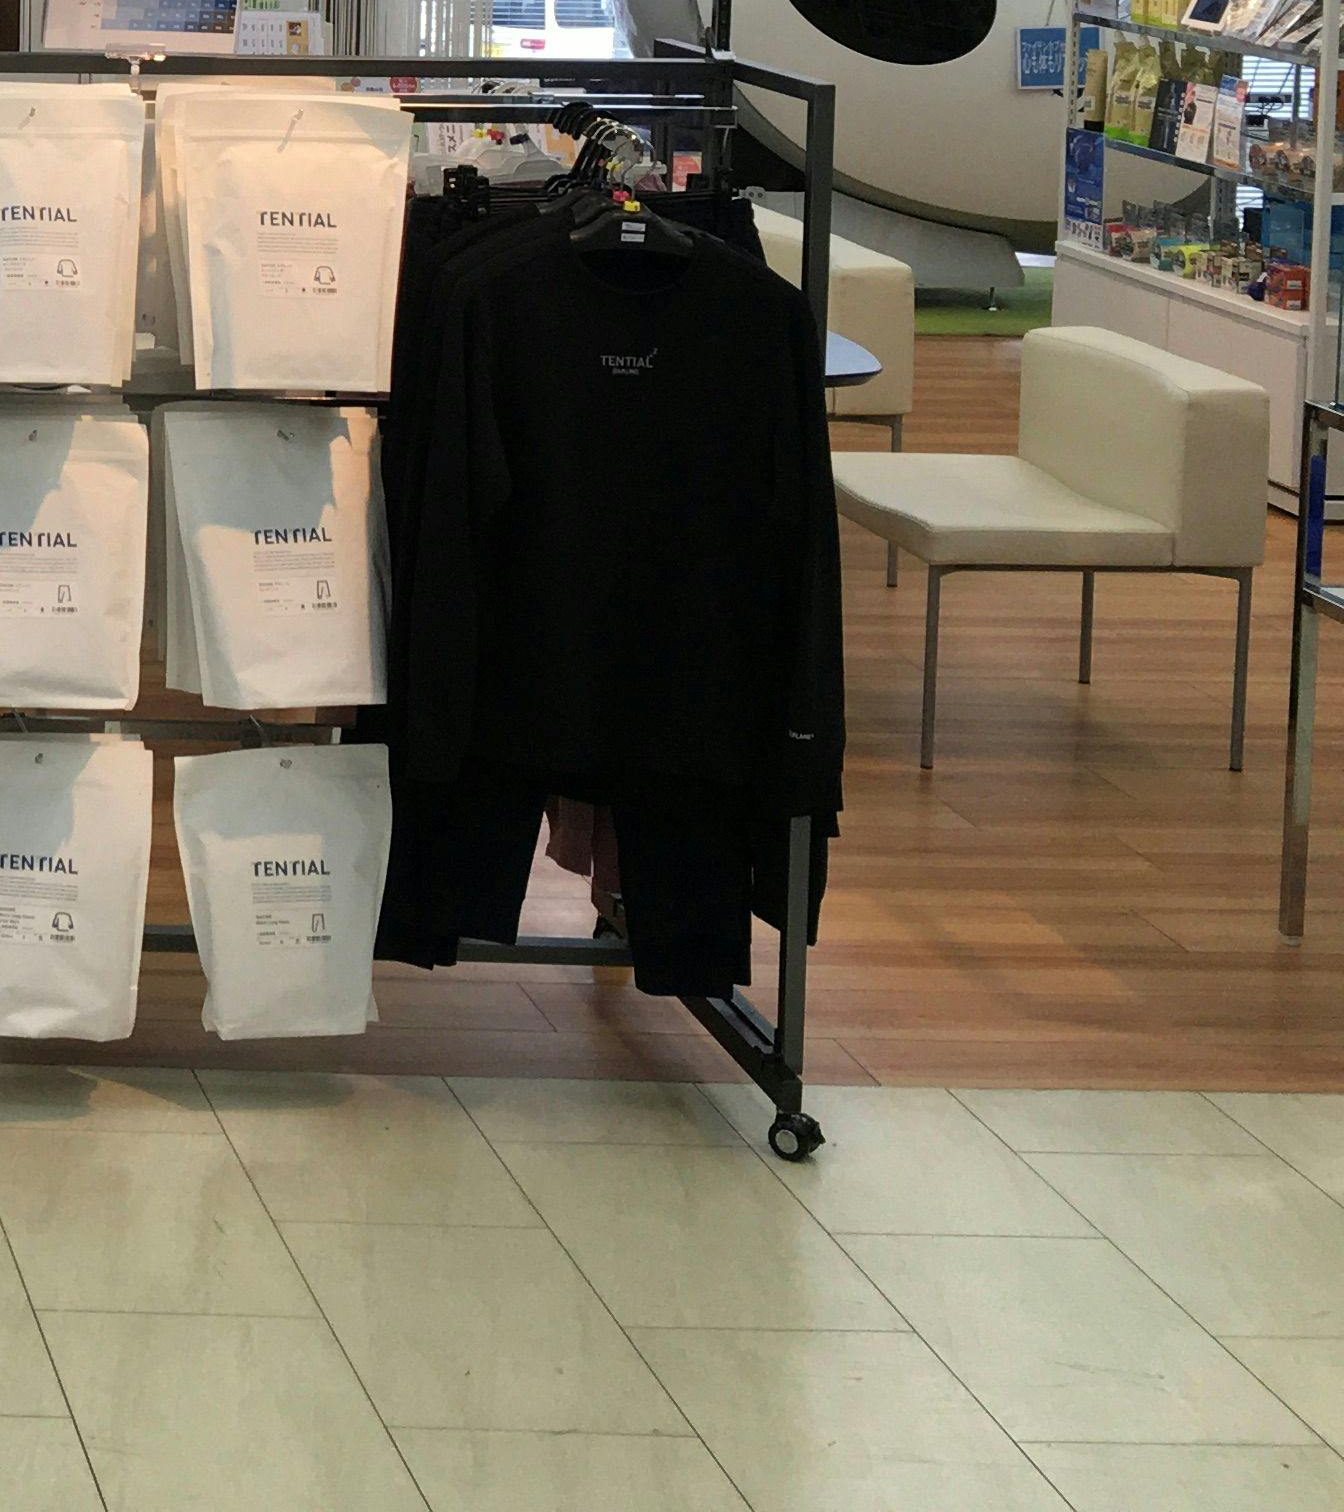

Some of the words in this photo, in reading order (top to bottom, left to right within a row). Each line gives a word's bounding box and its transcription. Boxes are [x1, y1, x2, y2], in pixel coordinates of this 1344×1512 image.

[0, 206, 77, 222] TENTIAL
[258, 212, 337, 228] TENTIAL
[600, 353, 654, 368] TENTIAL
[252, 527, 332, 545] TENTIAL
[251, 860, 330, 876] TENTIAL
